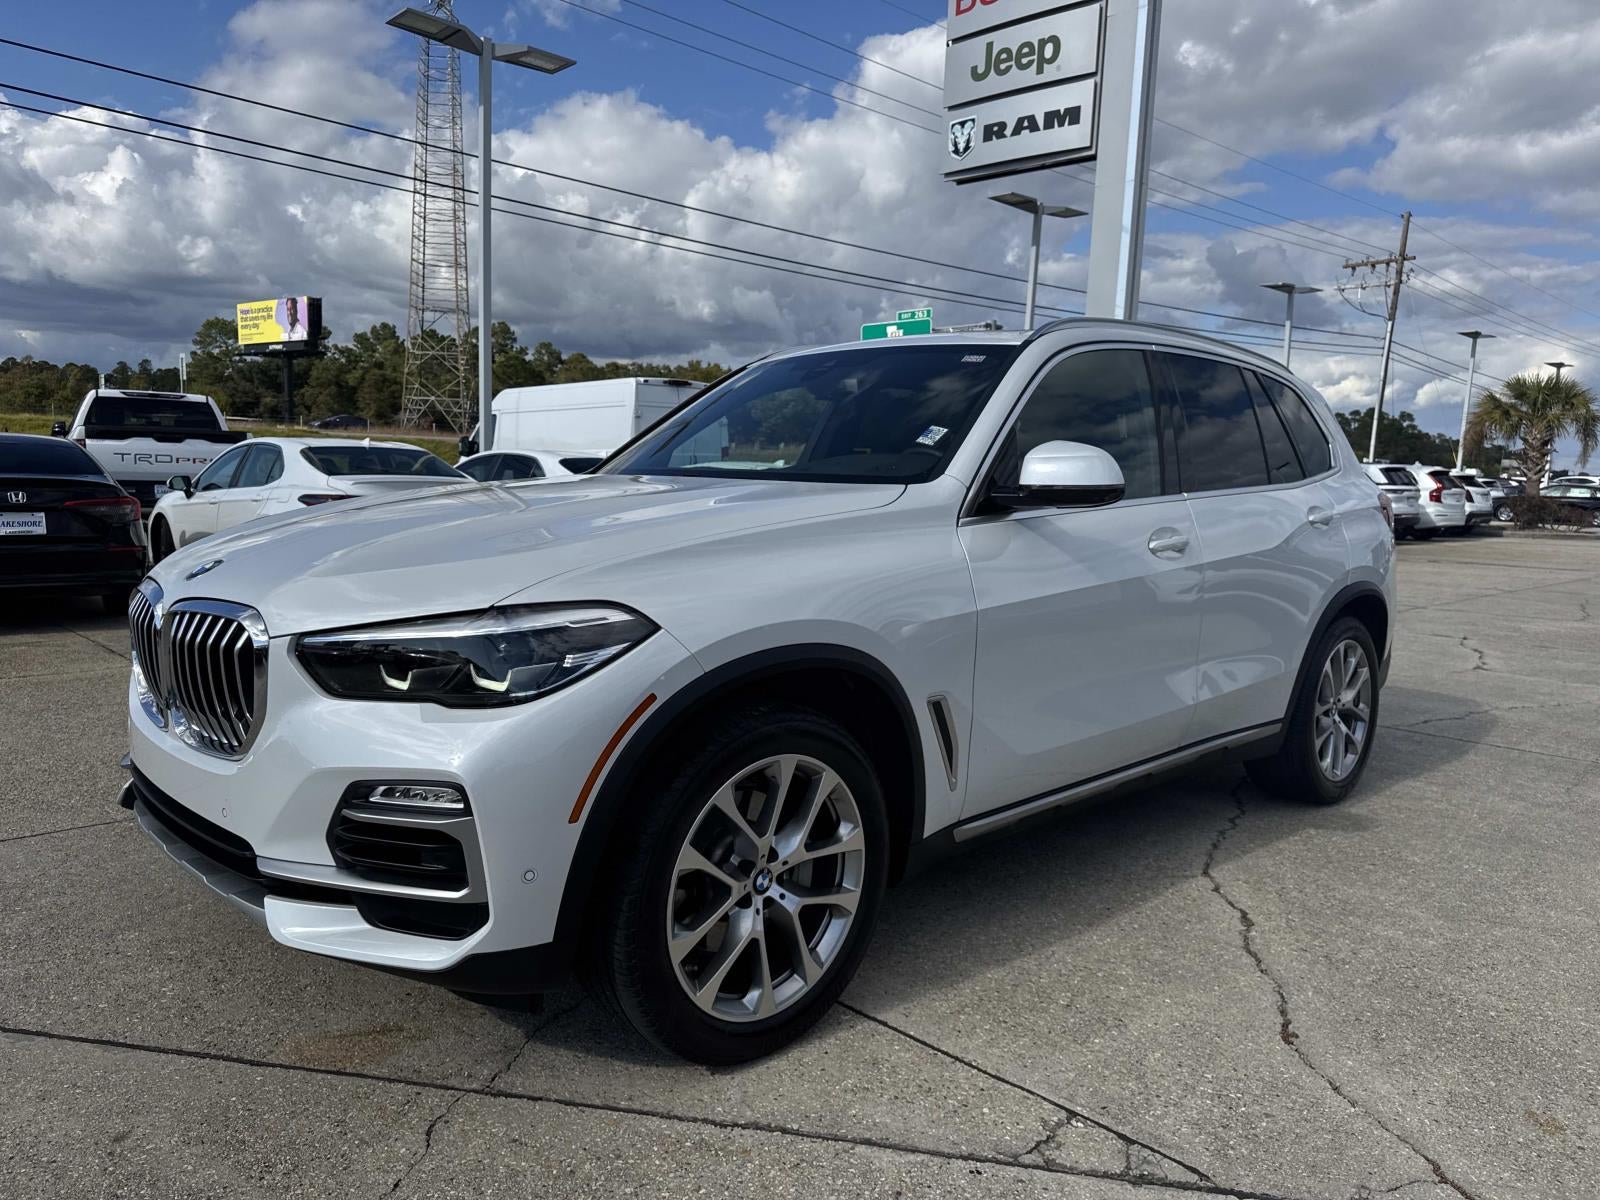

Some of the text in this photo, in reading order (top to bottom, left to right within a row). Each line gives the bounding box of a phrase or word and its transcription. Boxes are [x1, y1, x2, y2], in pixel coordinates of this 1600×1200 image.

[971, 35, 1061, 82] Jeep
[983, 105, 1082, 143] RAM
[914, 310, 927, 318] 263
[113, 452, 173, 465] TRD
[0, 520, 43, 528] AKESHORE
